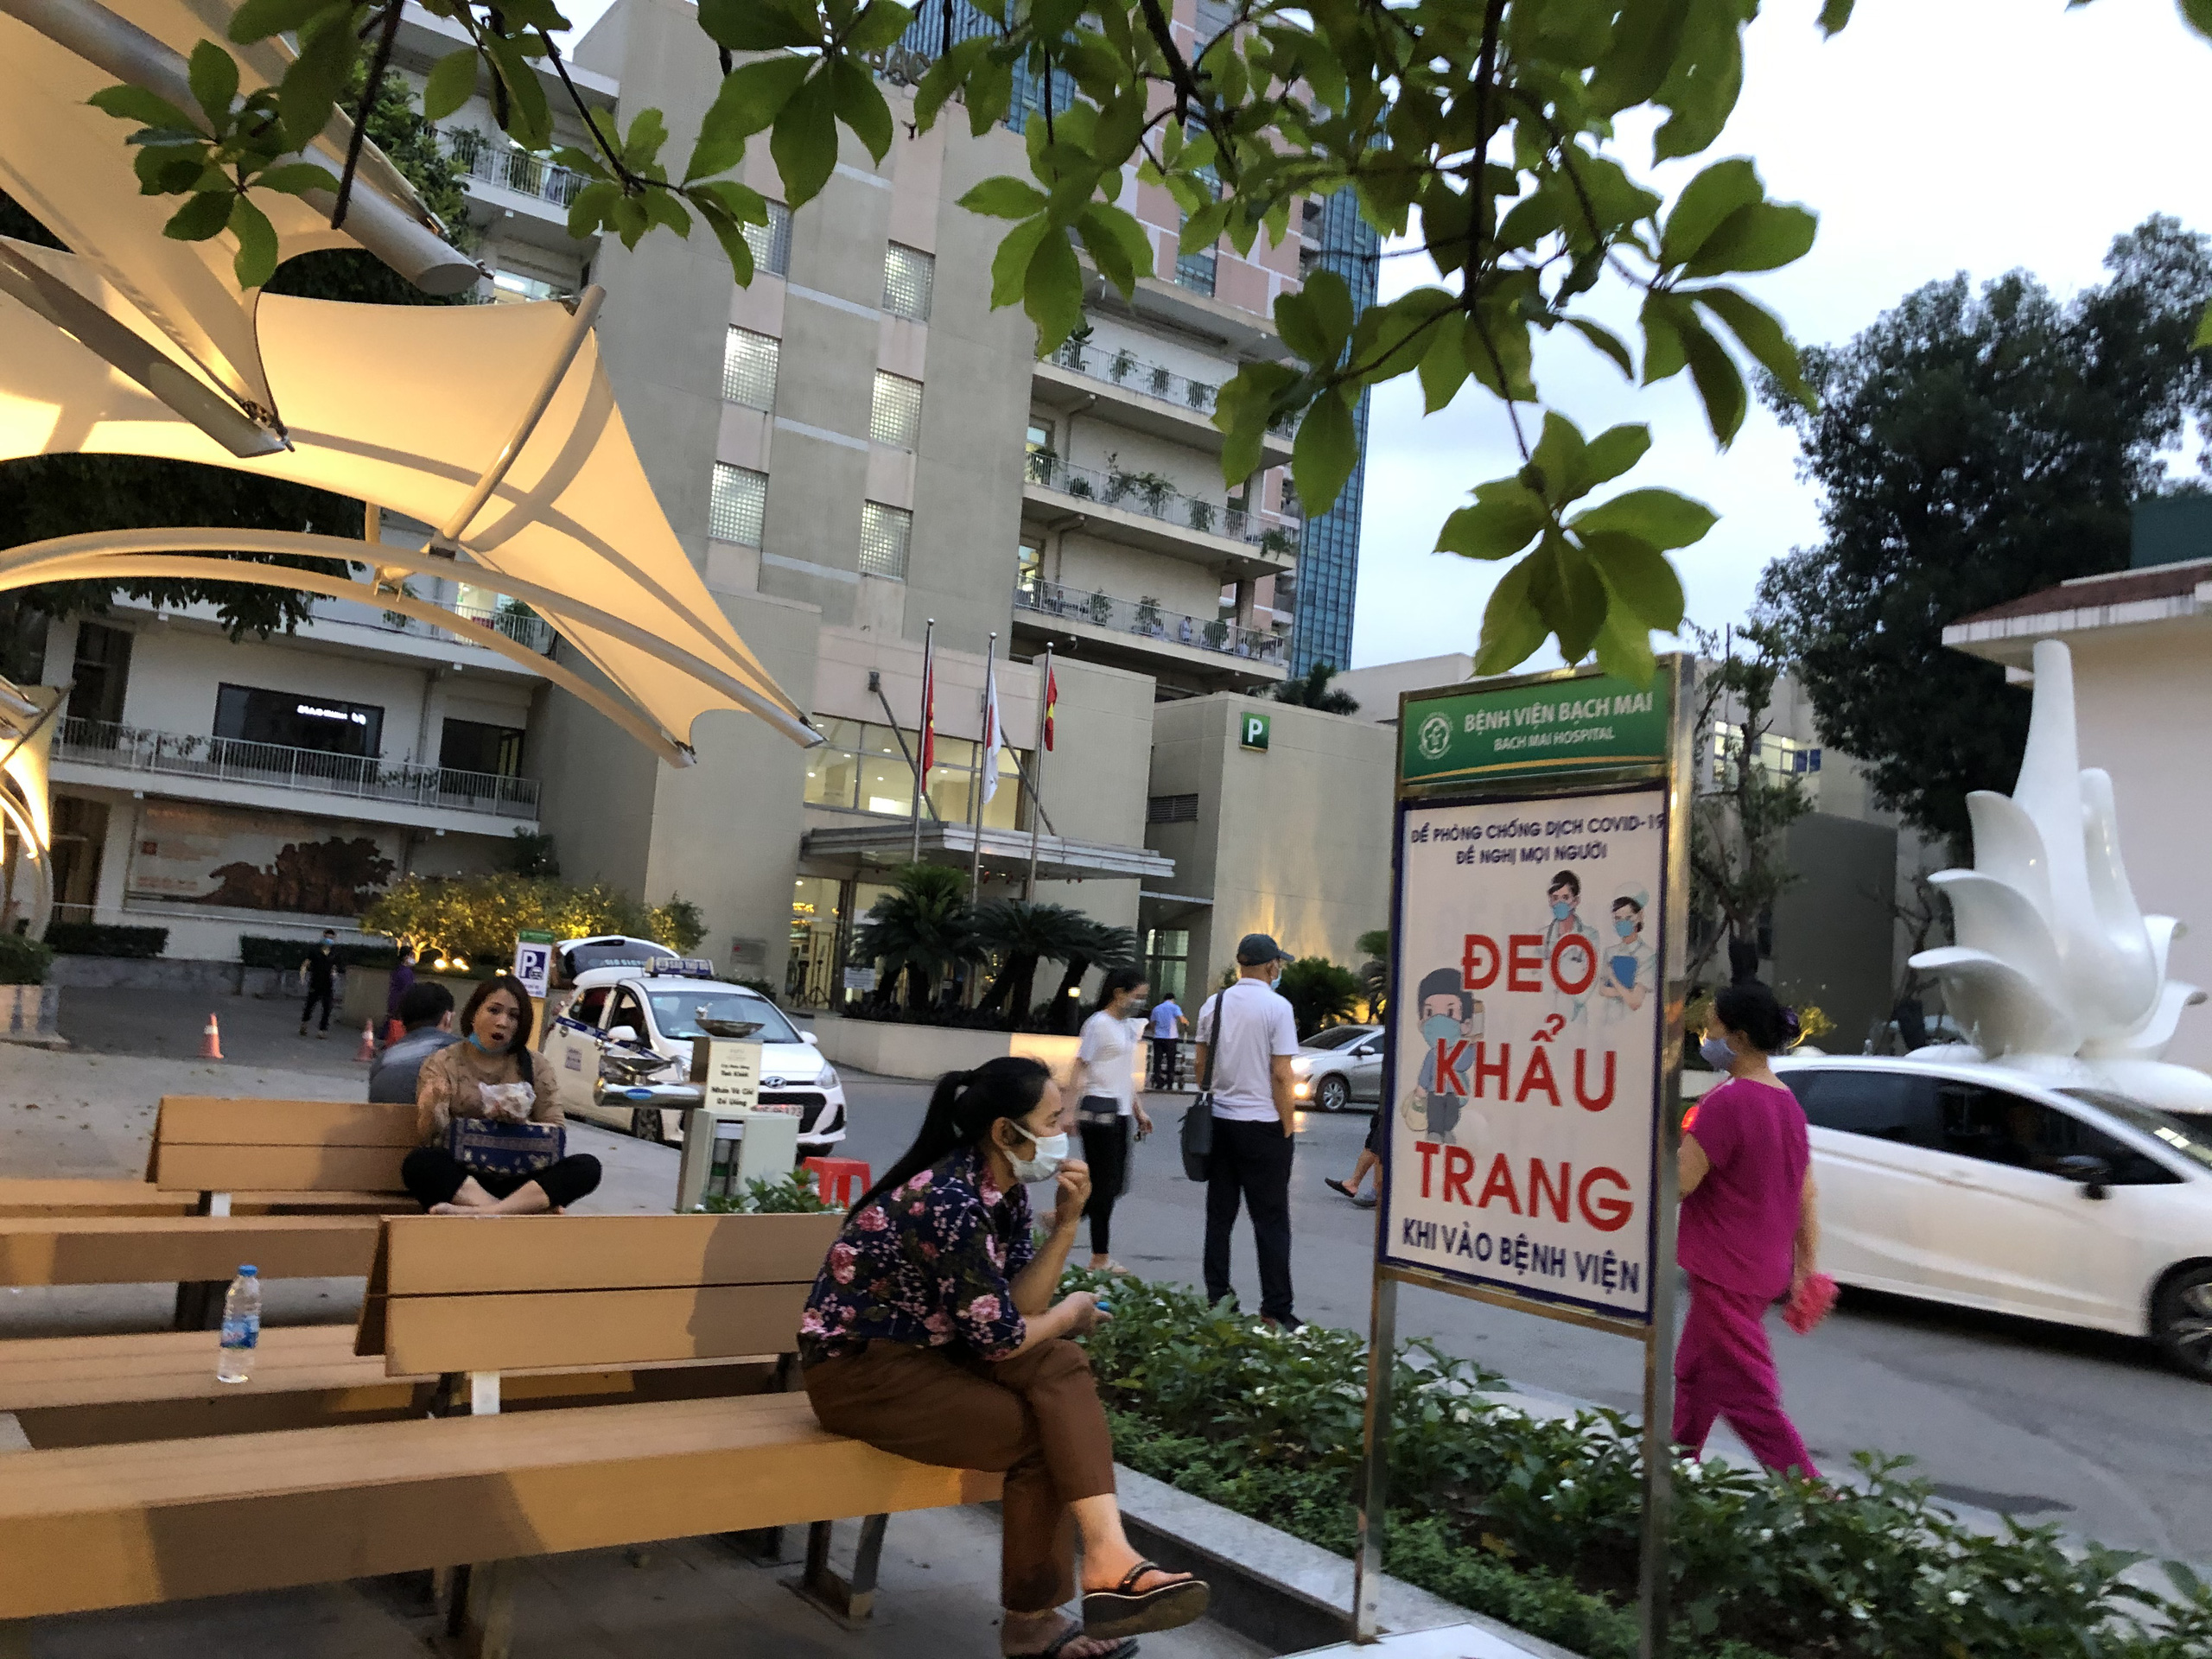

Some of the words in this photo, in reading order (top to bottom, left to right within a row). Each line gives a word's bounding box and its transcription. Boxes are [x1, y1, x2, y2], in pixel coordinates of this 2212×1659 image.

[1248, 718, 1263, 743] P
[1464, 709, 1511, 735] BỆNH
[1513, 702, 1555, 730] VIỆN
[1558, 696, 1611, 725] BẠCH
[1613, 691, 1654, 715] MAI
[1494, 735, 1527, 752] BACH
[1528, 733, 1552, 747] MAI
[1553, 726, 1616, 746] HOSPITAL
[1485, 817, 1541, 838] CHỐNG
[1545, 818, 1584, 838] DỊCH
[1586, 812, 1665, 833] COVID-19
[1519, 846, 1551, 864] MỌI
[521, 951, 537, 977] P
[1461, 933, 1598, 995] ĐEO
[1435, 1014, 1617, 1113] KHẨU
[1414, 1140, 1634, 1232] TRANG
[1402, 1217, 1438, 1250] KHI
[1441, 1221, 1493, 1262] VÀO
[1500, 1232, 1567, 1278] BỆNH
[1573, 1249, 1640, 1294] VIỆN
